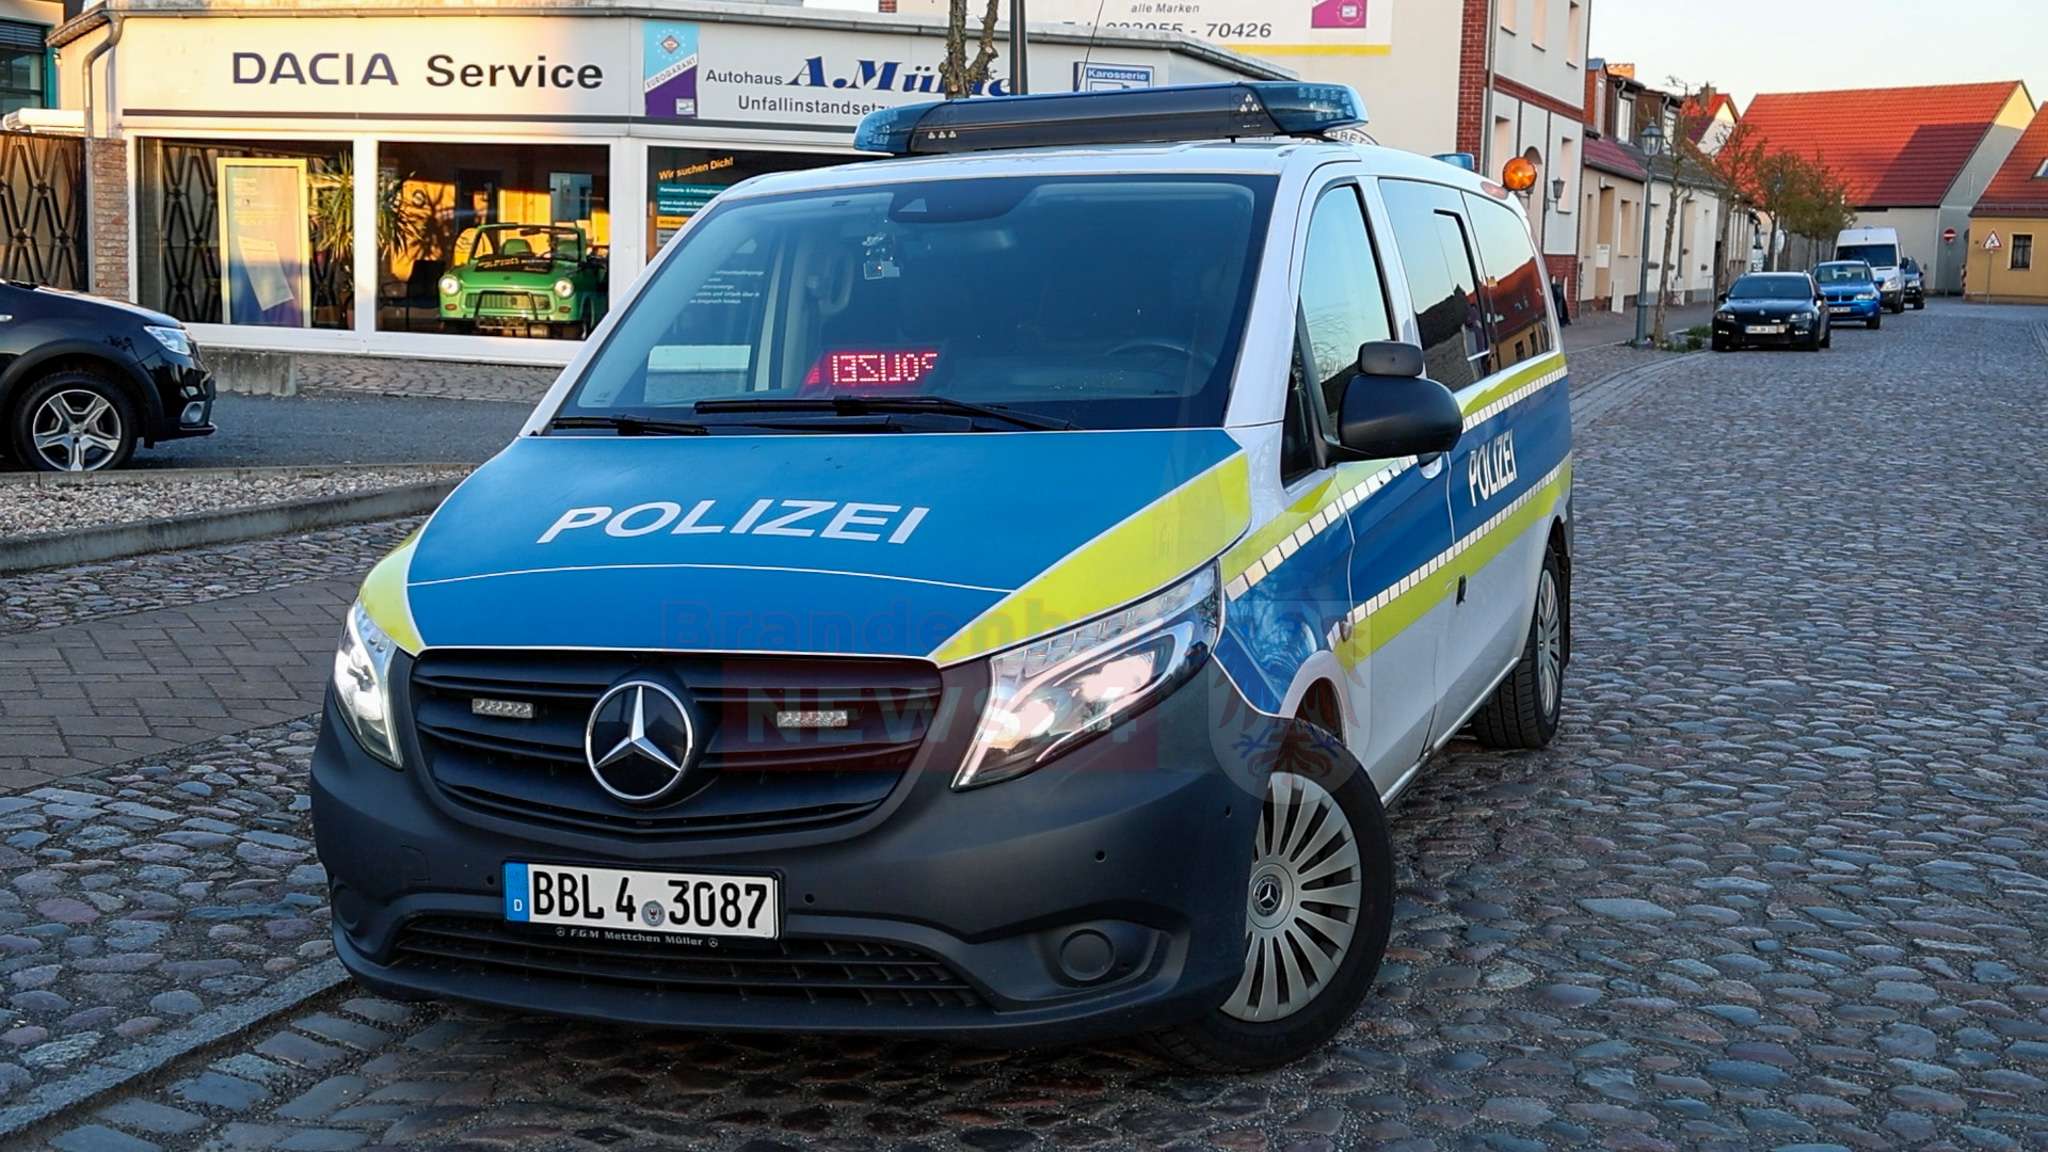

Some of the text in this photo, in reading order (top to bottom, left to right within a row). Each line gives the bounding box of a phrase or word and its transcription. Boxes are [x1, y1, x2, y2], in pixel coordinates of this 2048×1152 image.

[1131, 3, 1200, 13] alle Marken
[1206, 23, 1272, 38] 70426
[232, 52, 603, 89] DACIA Service
[705, 69, 783, 86] Autohaus
[1087, 69, 1147, 81] Karosserie
[659, 156, 734, 180] Wir suchen Dich!
[1468, 428, 1518, 507] POLIZEI
[536, 498, 930, 545] POLIZEI
[513, 870, 768, 929] D BBL 4 3087
[604, 931, 661, 943] Mettchen
[665, 935, 704, 946] Müller
